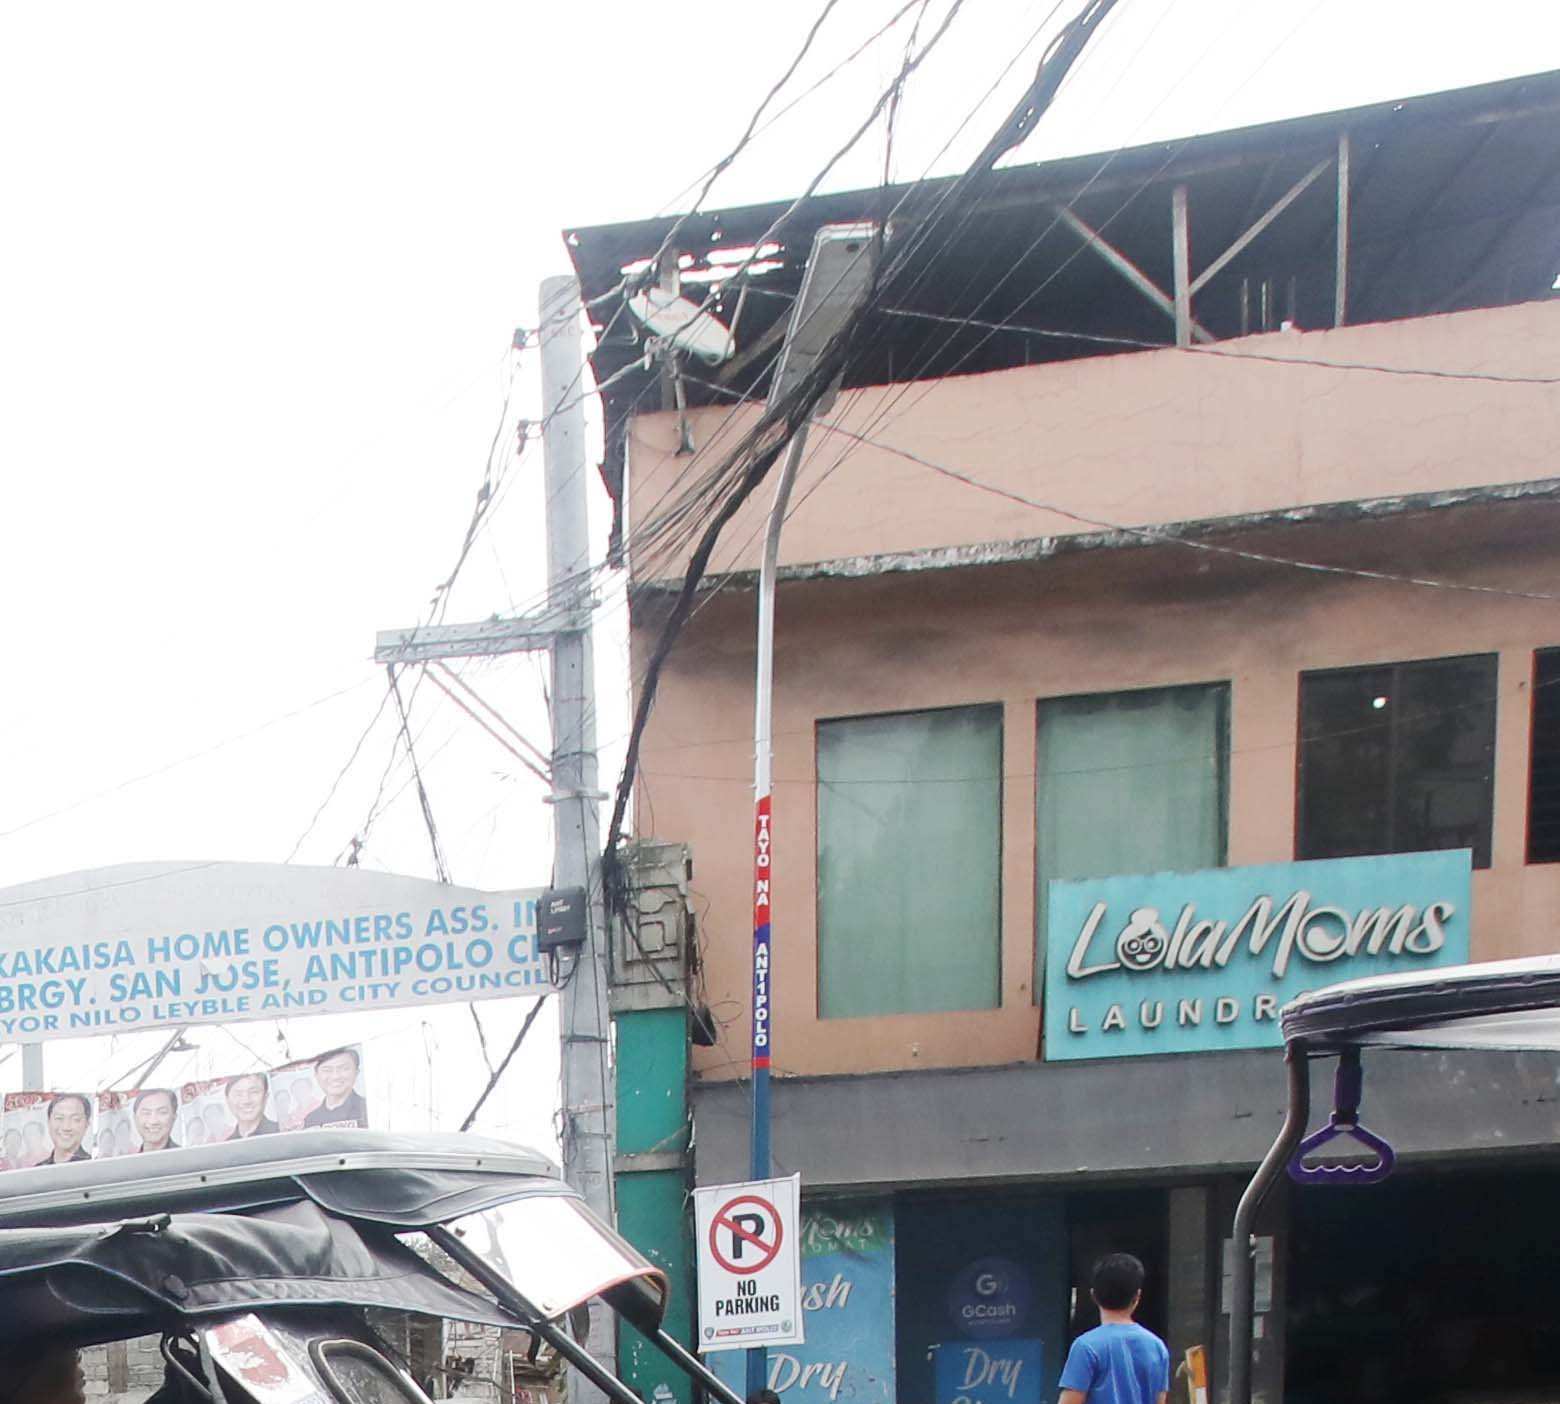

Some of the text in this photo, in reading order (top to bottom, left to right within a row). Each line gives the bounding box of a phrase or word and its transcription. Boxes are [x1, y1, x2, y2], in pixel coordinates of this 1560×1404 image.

[756, 814, 770, 868] TAYO
[756, 879, 769, 906] NA
[147, 926, 251, 965] HOME
[262, 911, 413, 952] OWNERS
[425, 904, 499, 937] ASS.
[110, 966, 181, 1001] SAN
[304, 940, 494, 985] ANTIPOLO
[70, 1005, 142, 1028] NILO
[152, 996, 250, 1021] LEYBLE
[261, 988, 329, 1010] AND
[339, 982, 400, 1003] CITY
[412, 968, 550, 996] COUNCIL
[1068, 992, 1316, 1034] LAUNDR
[715, 1293, 780, 1317] PARKING
[736, 1279, 757, 1298] NO
[961, 1303, 1016, 1319] GCash
[765, 1352, 849, 1401] Dry
[957, 1347, 1024, 1398] Dry
